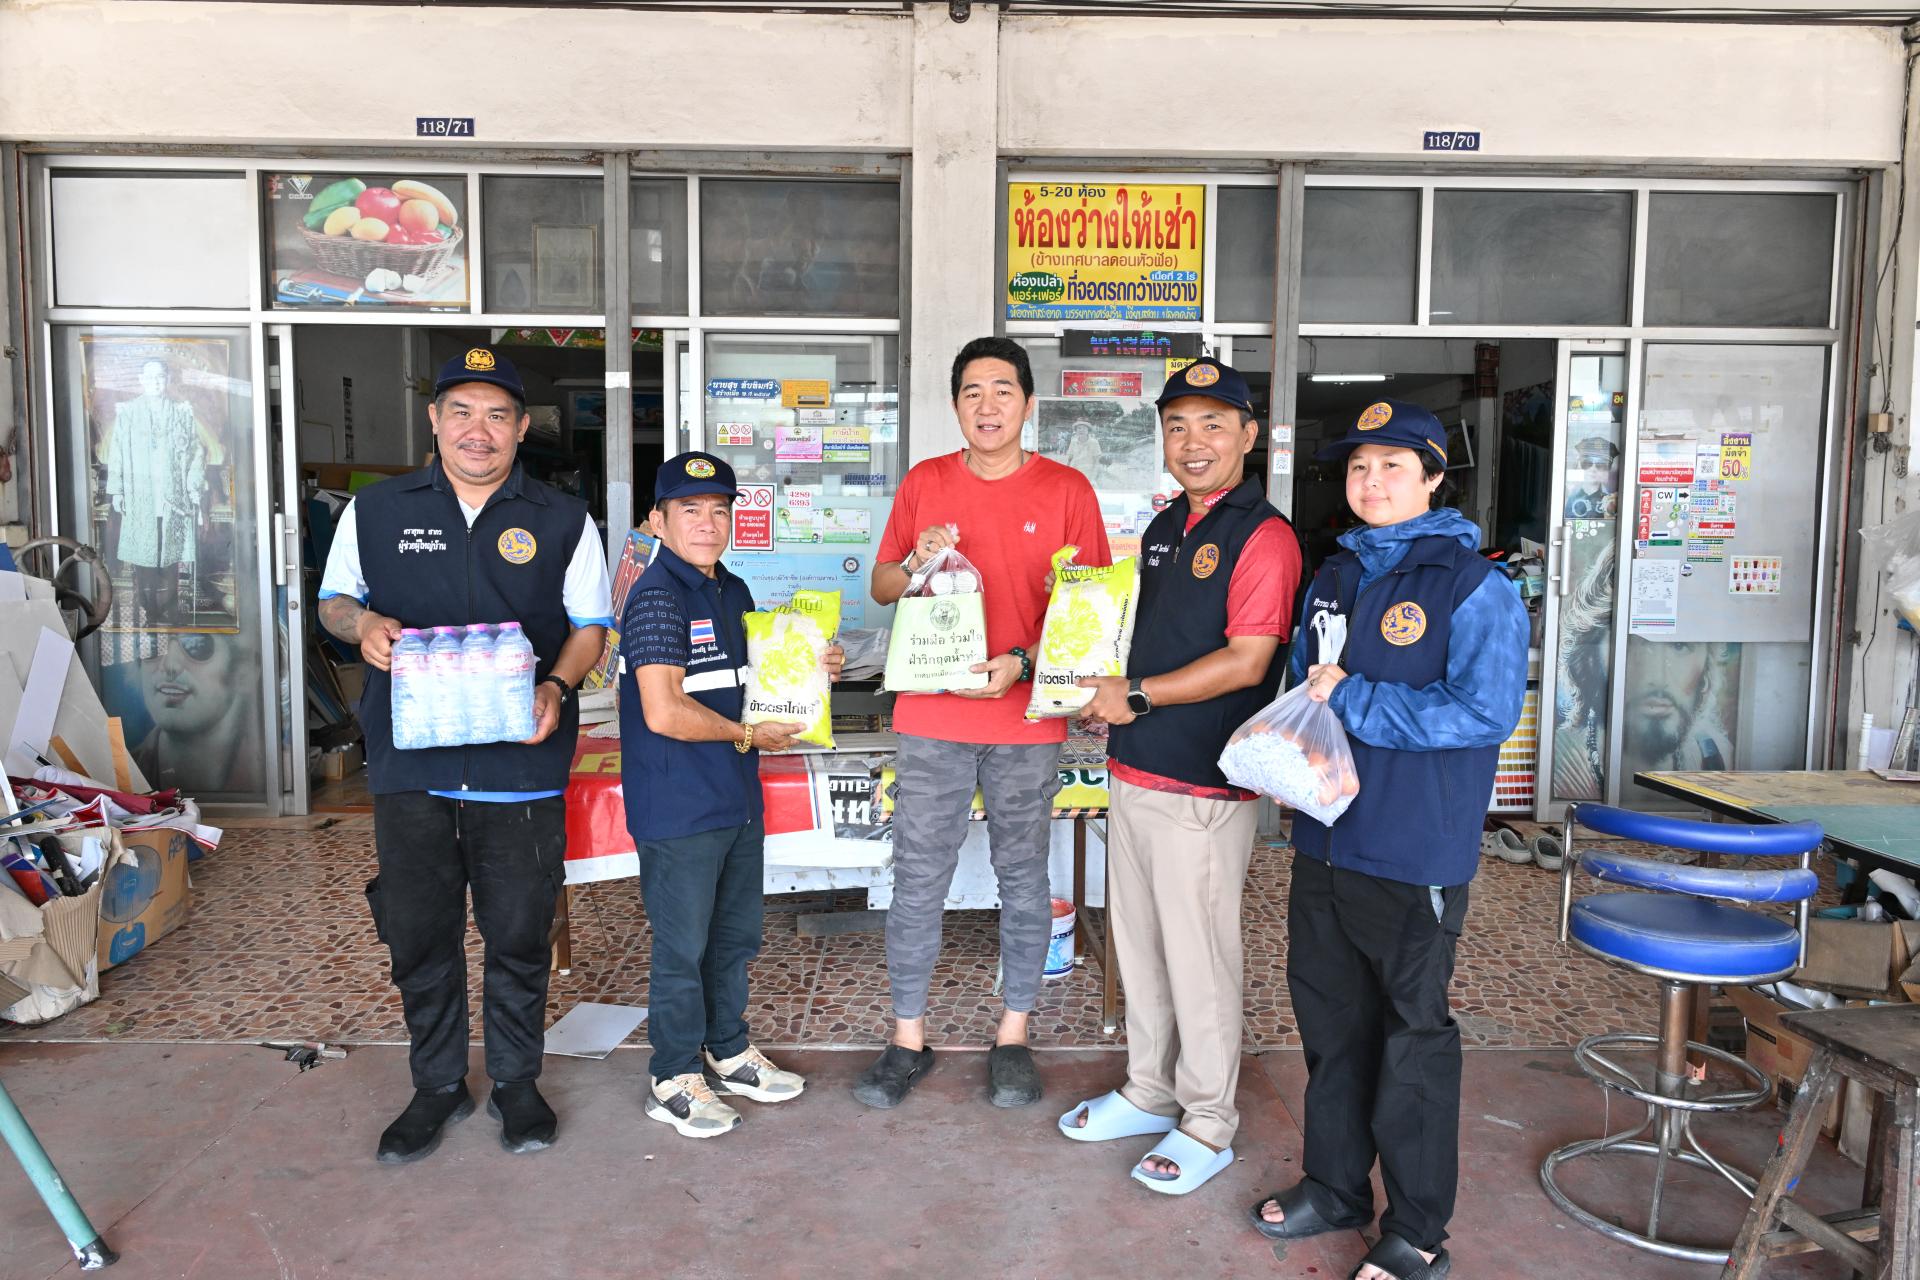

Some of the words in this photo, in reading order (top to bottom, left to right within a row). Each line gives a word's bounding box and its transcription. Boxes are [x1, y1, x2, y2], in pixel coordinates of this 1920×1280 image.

[421, 118, 469, 136] 118/71
[1427, 133, 1476, 150] 118/70
[1040, 186, 1073, 198] 5-20
[1078, 184, 1105, 198] ห้อง
[1014, 188, 1196, 250] ห้องว่างให้เช่า
[1013, 272, 1063, 287] ห้องเปล่า
[1177, 272, 1183, 281] 2
[1013, 287, 1062, 301] แอร์+เฟอร์
[1067, 270, 1197, 302] ที่จอดรถกว้างขวาง
[1722, 459, 1749, 479] 50%
[639, 636, 659, 644] miss
[662, 636, 678, 644] you
